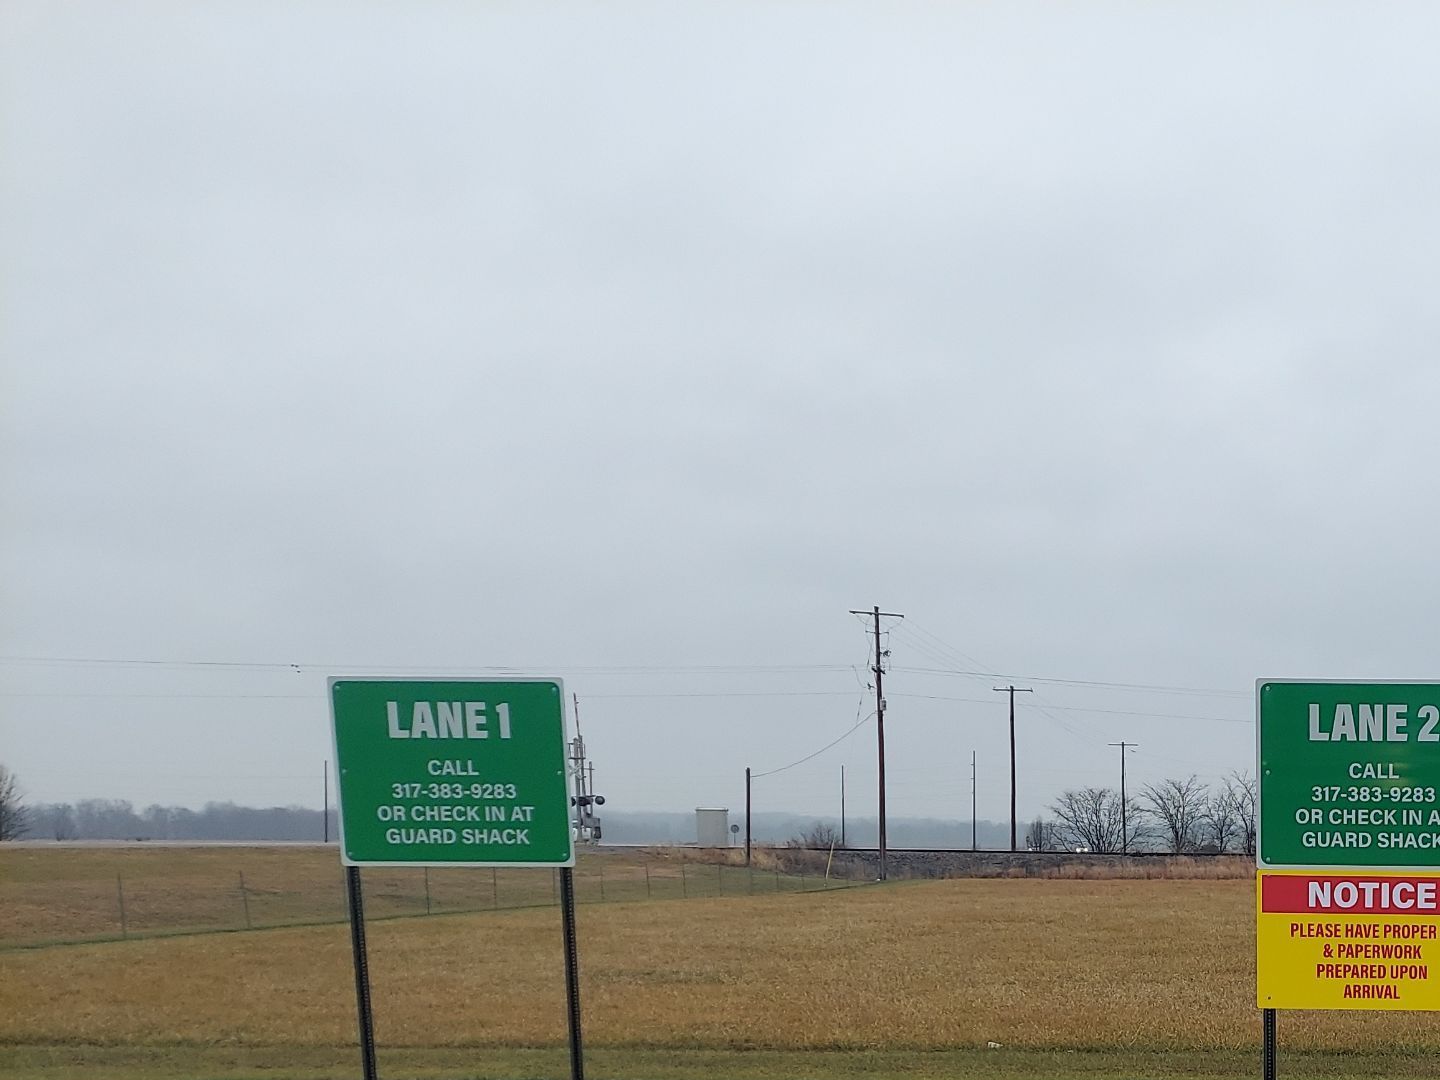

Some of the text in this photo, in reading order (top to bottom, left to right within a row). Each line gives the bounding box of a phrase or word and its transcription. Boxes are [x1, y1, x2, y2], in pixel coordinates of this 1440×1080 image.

[386, 701, 511, 739] LANE 1
[1308, 704, 1440, 742] LANE 2
[428, 760, 479, 776] CALL
[1349, 763, 1399, 779] CALL
[392, 783, 517, 799] 317-383-9283
[1312, 787, 1436, 802] 317-383-9283
[377, 806, 534, 821] OR CHECK IN AT
[1295, 809, 1322, 824] OR
[1329, 809, 1397, 825] CHECK
[1402, 810, 1422, 825] IN
[386, 829, 530, 845] GUARD SHACK
[1302, 832, 1372, 848] GUARD
[1308, 882, 1437, 909] NOTICE
[1291, 923, 1341, 938] PLEASE
[1345, 924, 1380, 938] HAVE
[1384, 925, 1437, 939] PROPER
[1323, 944, 1422, 960] & PAPERWORK
[1316, 964, 1428, 980] PREPARED UPON
[1343, 984, 1400, 999] ARRIVAL
